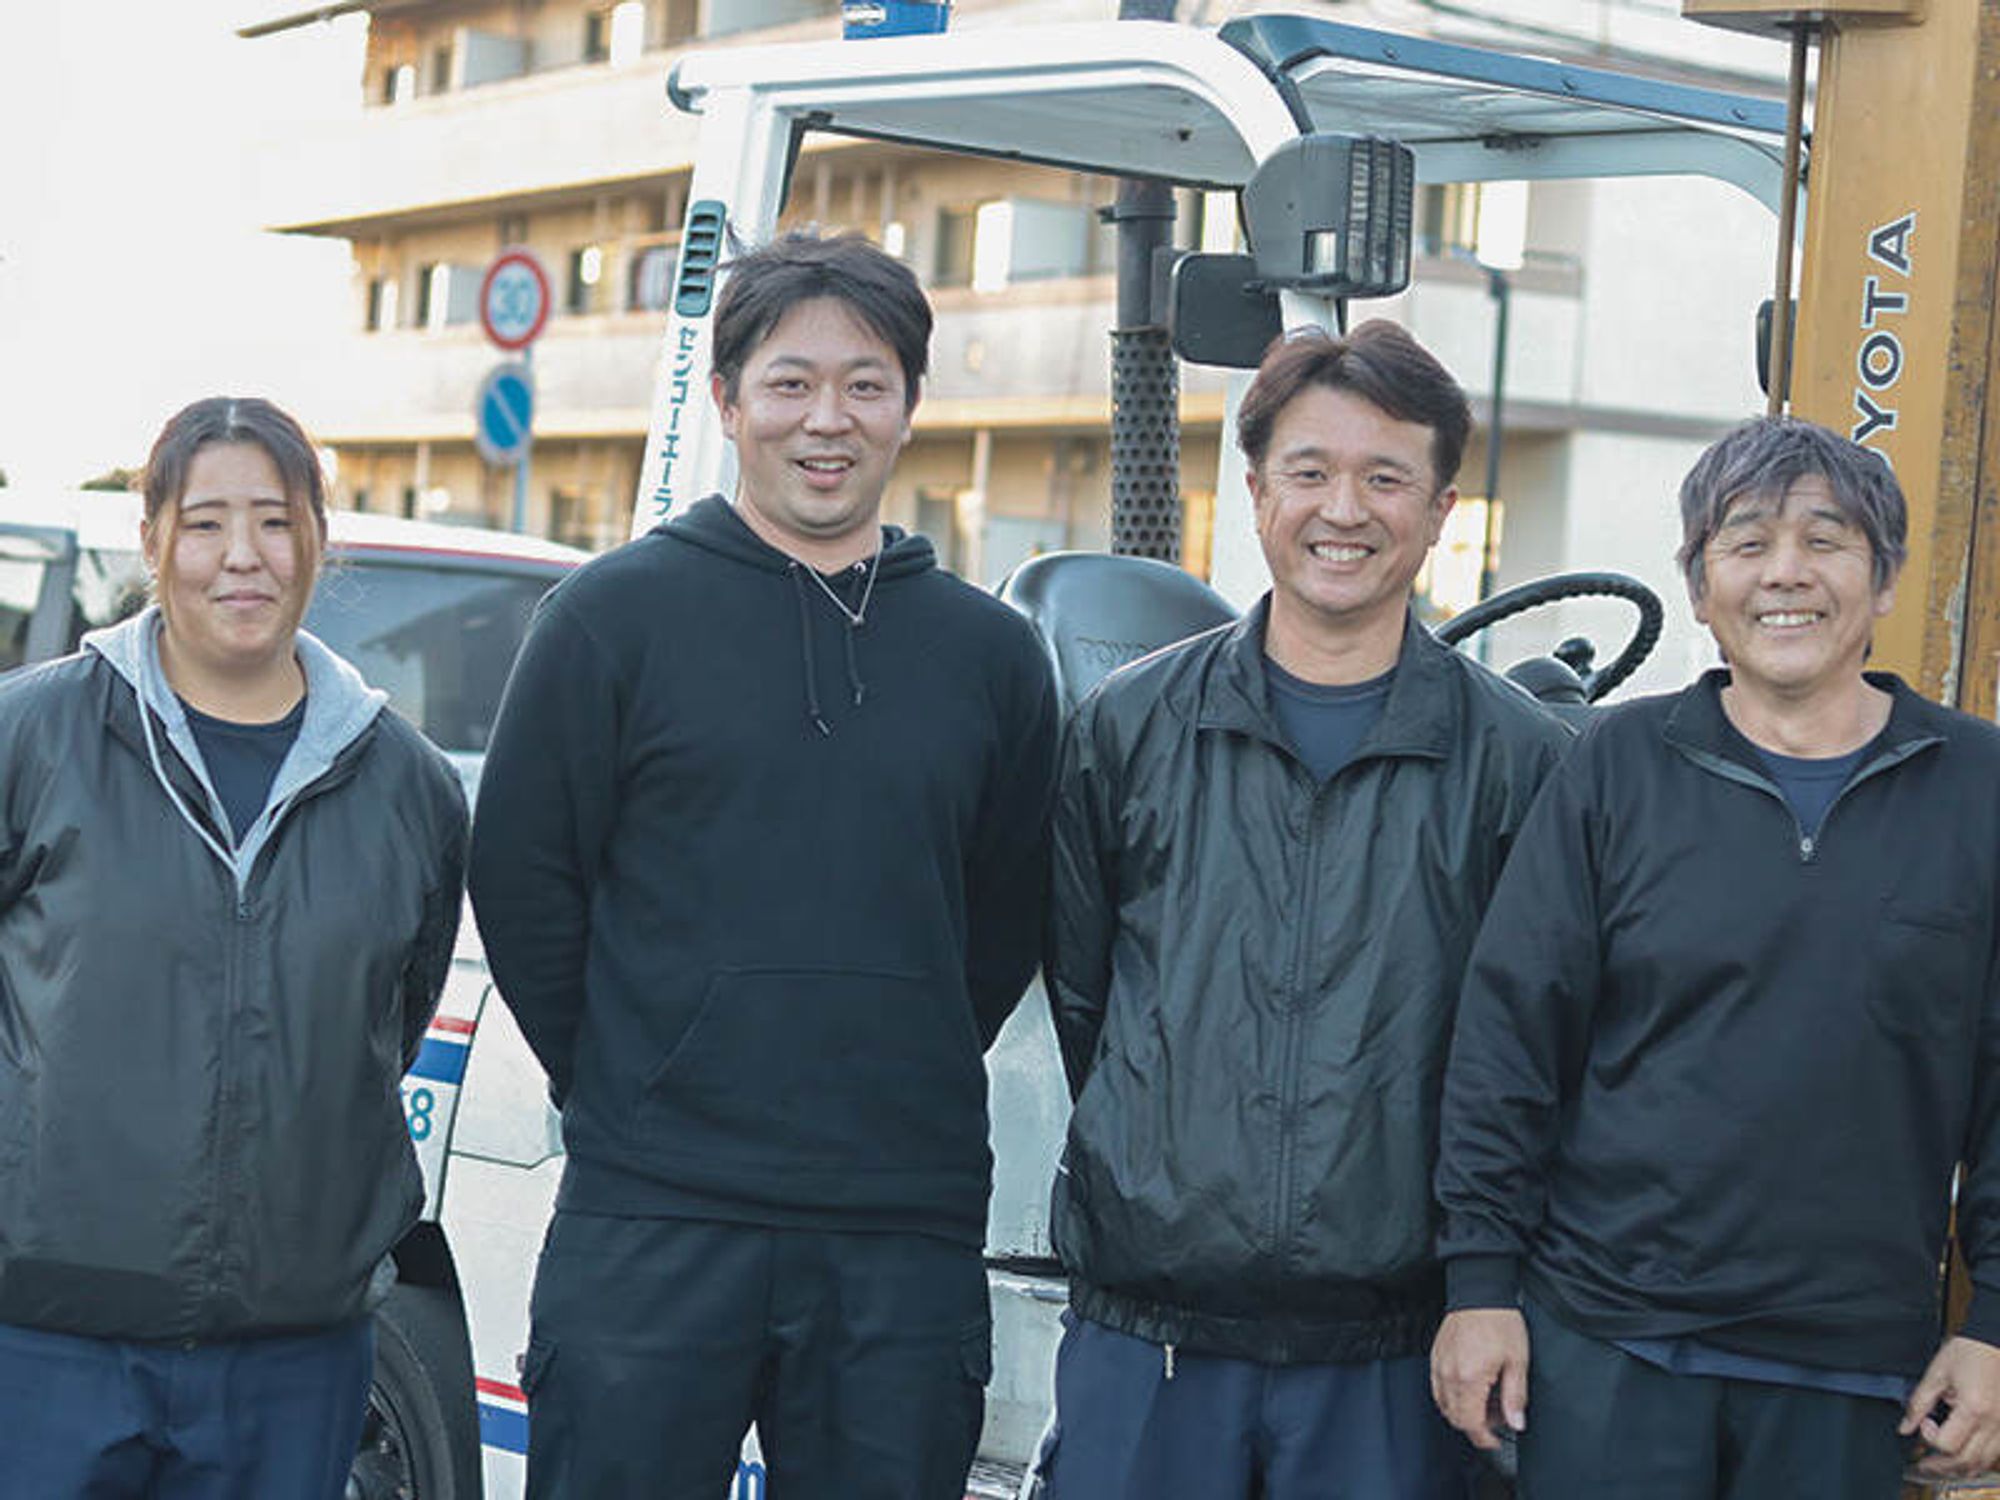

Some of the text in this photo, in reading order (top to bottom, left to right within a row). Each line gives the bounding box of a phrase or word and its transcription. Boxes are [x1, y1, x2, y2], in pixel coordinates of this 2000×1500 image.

[652, 326, 697, 525] センコーエーラ
[1853, 211, 1917, 464] YOTA
[401, 1087, 434, 1141] 8
